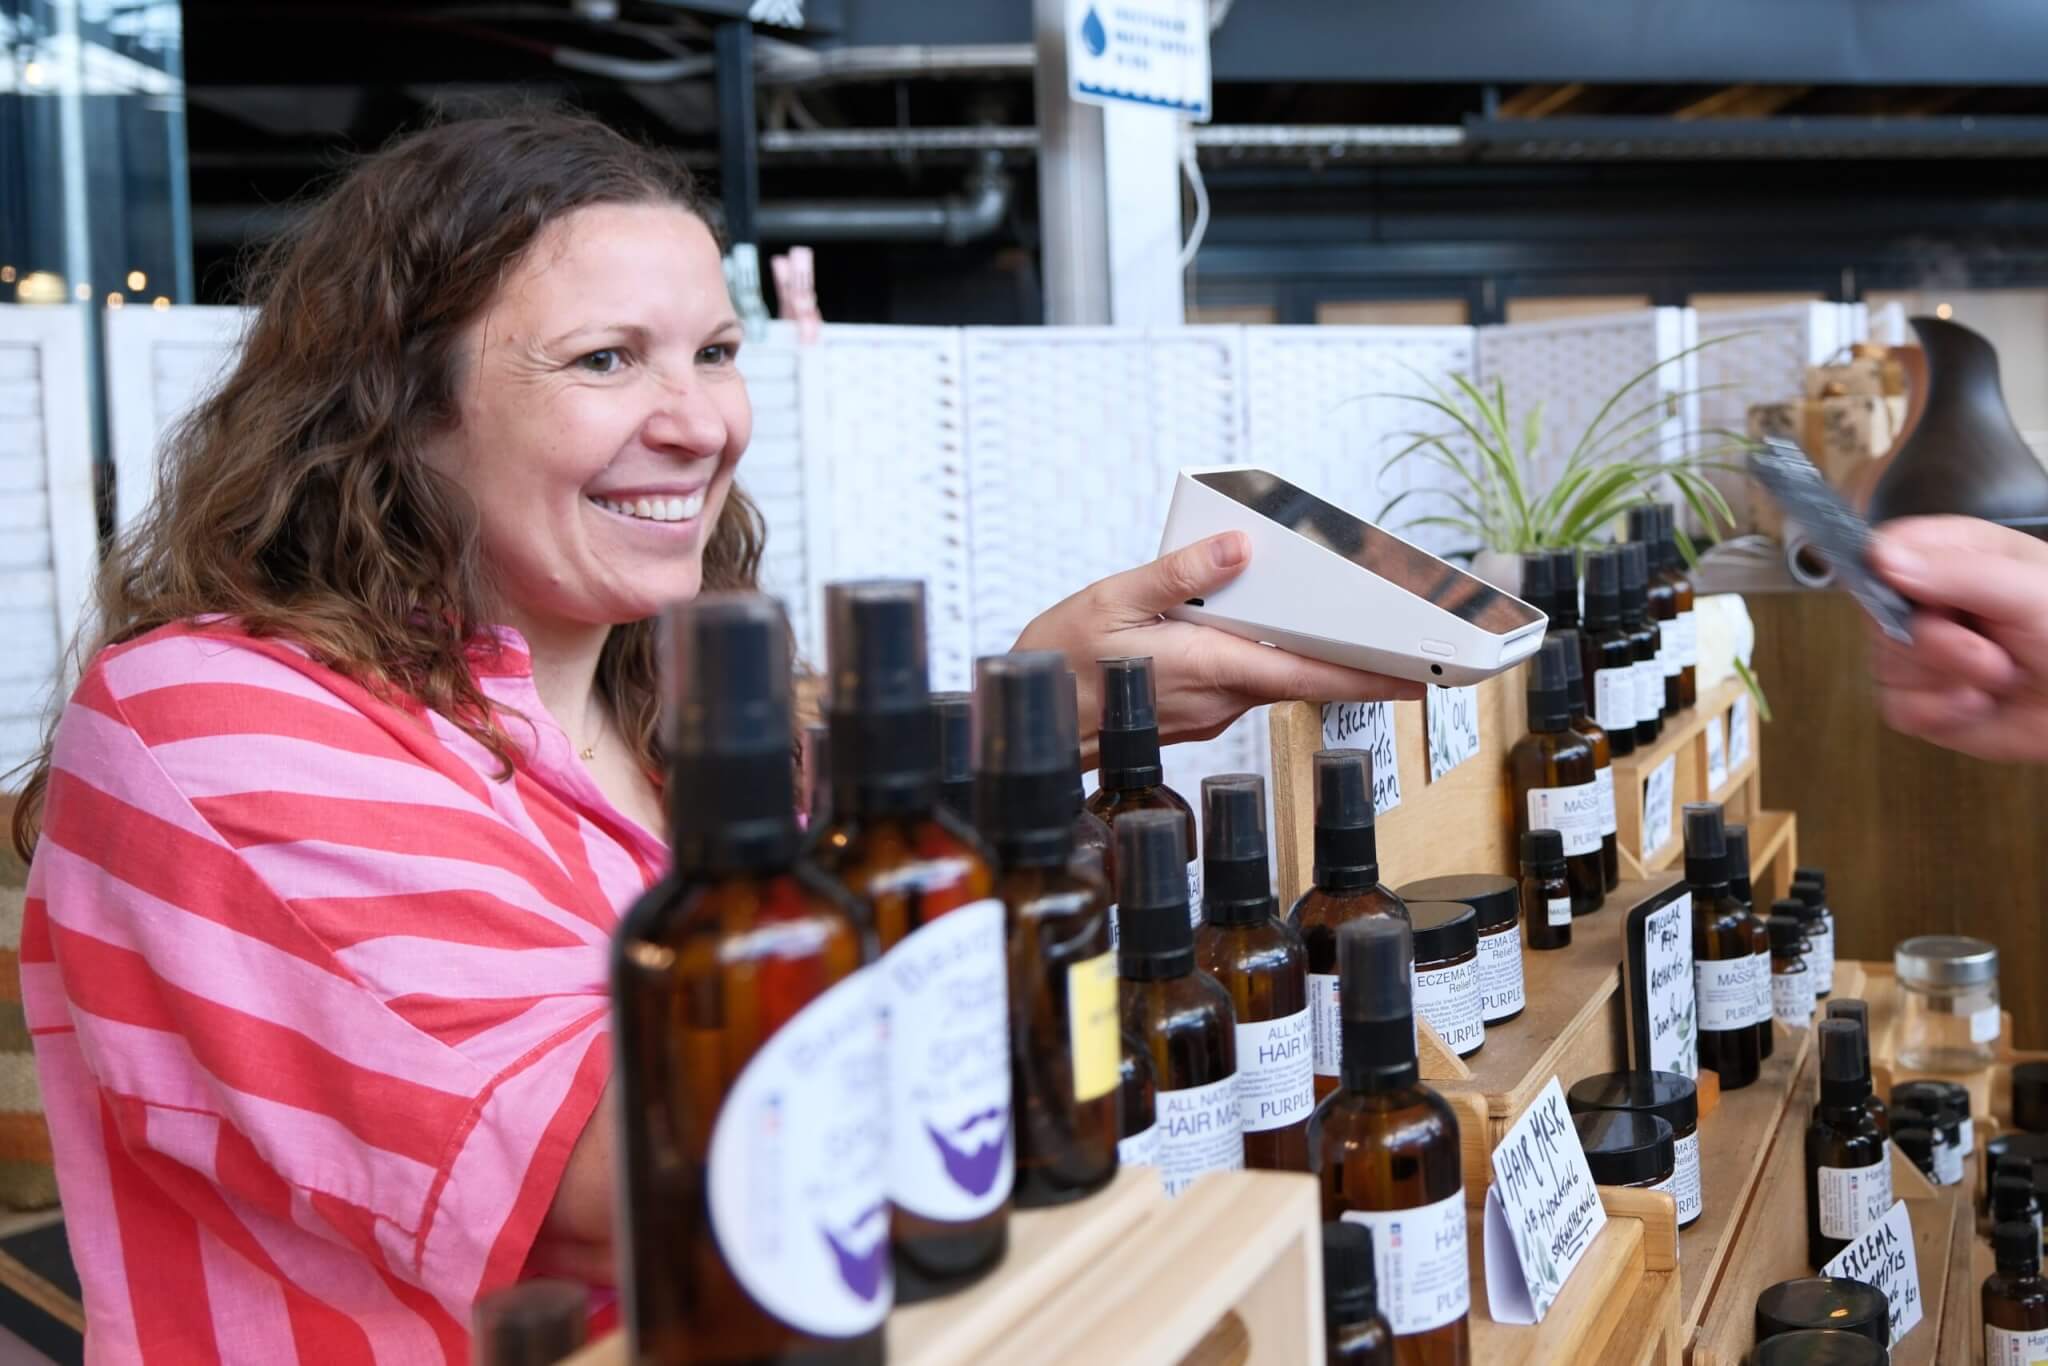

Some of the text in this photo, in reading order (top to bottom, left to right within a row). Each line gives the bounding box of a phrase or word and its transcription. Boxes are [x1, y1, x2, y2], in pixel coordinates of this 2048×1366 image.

[1417, 967, 1466, 988] ECZEMA
[1449, 978, 1471, 994] Relief
[1481, 986, 1521, 1010] PURPLE
[1268, 1021, 1291, 1041] ALL
[1258, 1036, 1301, 1064] HAIR
[1167, 1097, 1195, 1112] ALL
[1260, 1087, 1310, 1118] PURPLE
[1159, 1111, 1211, 1137] HAIR
[1501, 1096, 1566, 1206] HAIR MASK
[1538, 1160, 1579, 1237] HYDRATING
